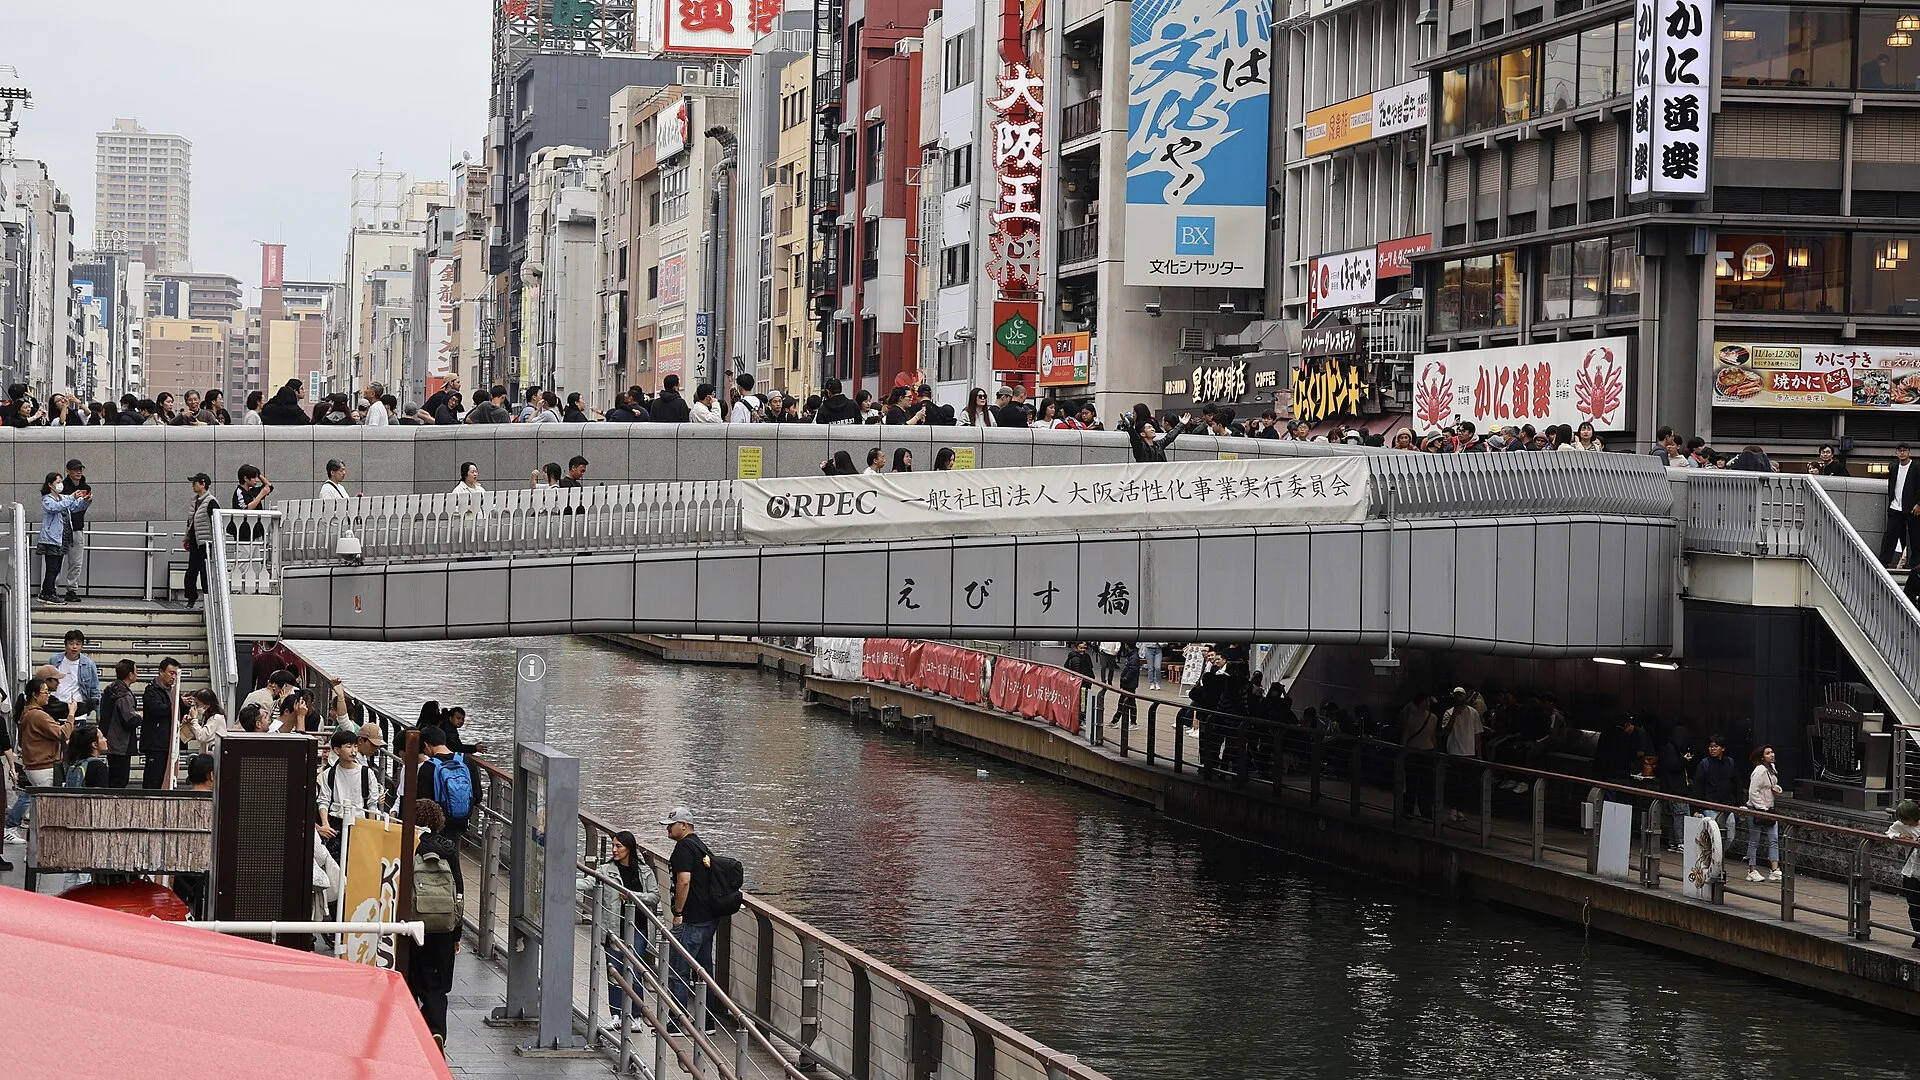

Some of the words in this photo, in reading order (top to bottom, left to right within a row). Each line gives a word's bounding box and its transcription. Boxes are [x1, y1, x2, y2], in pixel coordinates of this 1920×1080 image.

[987, 64, 1043, 288] 大阪王将
[1180, 226, 1210, 245] BX
[1301, 328, 1356, 353] ハンバーグレストラン
[1815, 351, 1872, 369] かにすき
[1192, 360, 1247, 403] 星乃珈琲店
[1255, 369, 1277, 388] COFFEE
[1292, 358, 1370, 421] びっくりドンキー
[1772, 372, 1821, 390] 焼かに
[900, 485, 1059, 511] 一般社団法人
[1068, 473, 1351, 504] 大阪活性化事業実行委員会
[897, 578, 1131, 616] えびす橋
